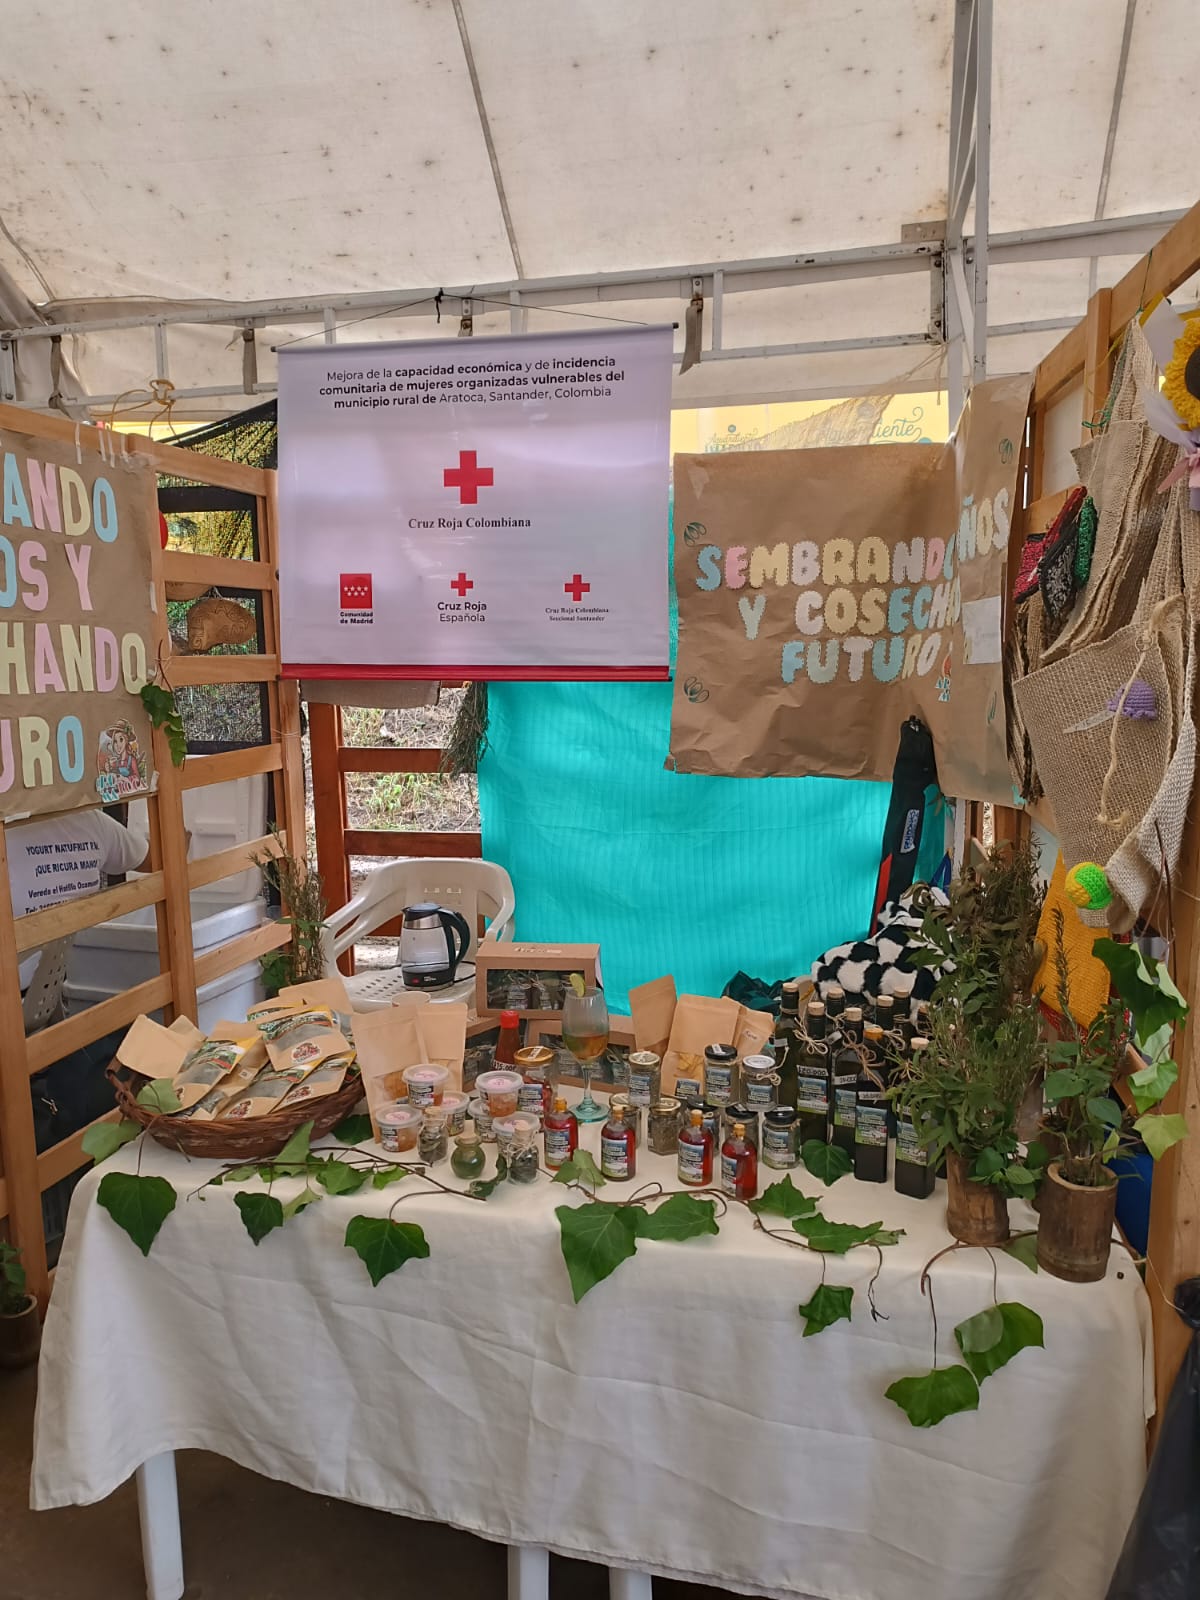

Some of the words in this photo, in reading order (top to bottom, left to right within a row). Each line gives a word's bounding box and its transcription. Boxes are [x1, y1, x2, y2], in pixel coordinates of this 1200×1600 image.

[327, 371, 364, 382] Mejora
[366, 369, 380, 379] de
[383, 368, 392, 378] la
[395, 364, 454, 378] capacidad
[457, 360, 522, 374] económica
[525, 362, 532, 373] y
[534, 360, 550, 370] de
[552, 356, 616, 369] incidencia
[319, 382, 387, 396] comunitaria
[389, 381, 404, 392] de
[406, 379, 453, 392] mujeres
[456, 375, 528, 390] organizadas
[531, 372, 602, 385] vulnerables
[605, 370, 625, 382] del
[334, 396, 390, 409] municipio
[393, 394, 419, 406] rural
[422, 394, 437, 404] de
[439, 392, 487, 404] Aratoca,
[489, 389, 552, 401] Santander,
[554, 385, 612, 399] Colombia
[3, 452, 119, 543] ANDO
[408, 518, 435, 528] Cruz
[438, 517, 463, 531] Roja
[466, 517, 531, 528] Colombiana
[64, 543, 93, 611] Y
[437, 602, 462, 611] Cruz
[464, 602, 487, 613] Roja
[439, 613, 486, 623] Española
[737, 594, 767, 640] Y
[781, 632, 942, 684] FUTURO
[26, 844, 53, 856] YOGURT
[55, 842, 89, 854] NATUFRUT
[35, 863, 51, 877] ¡QUE
[53, 862, 78, 873] RICURA
[28, 888, 51, 898] Vereda
[53, 886, 58, 894] el
